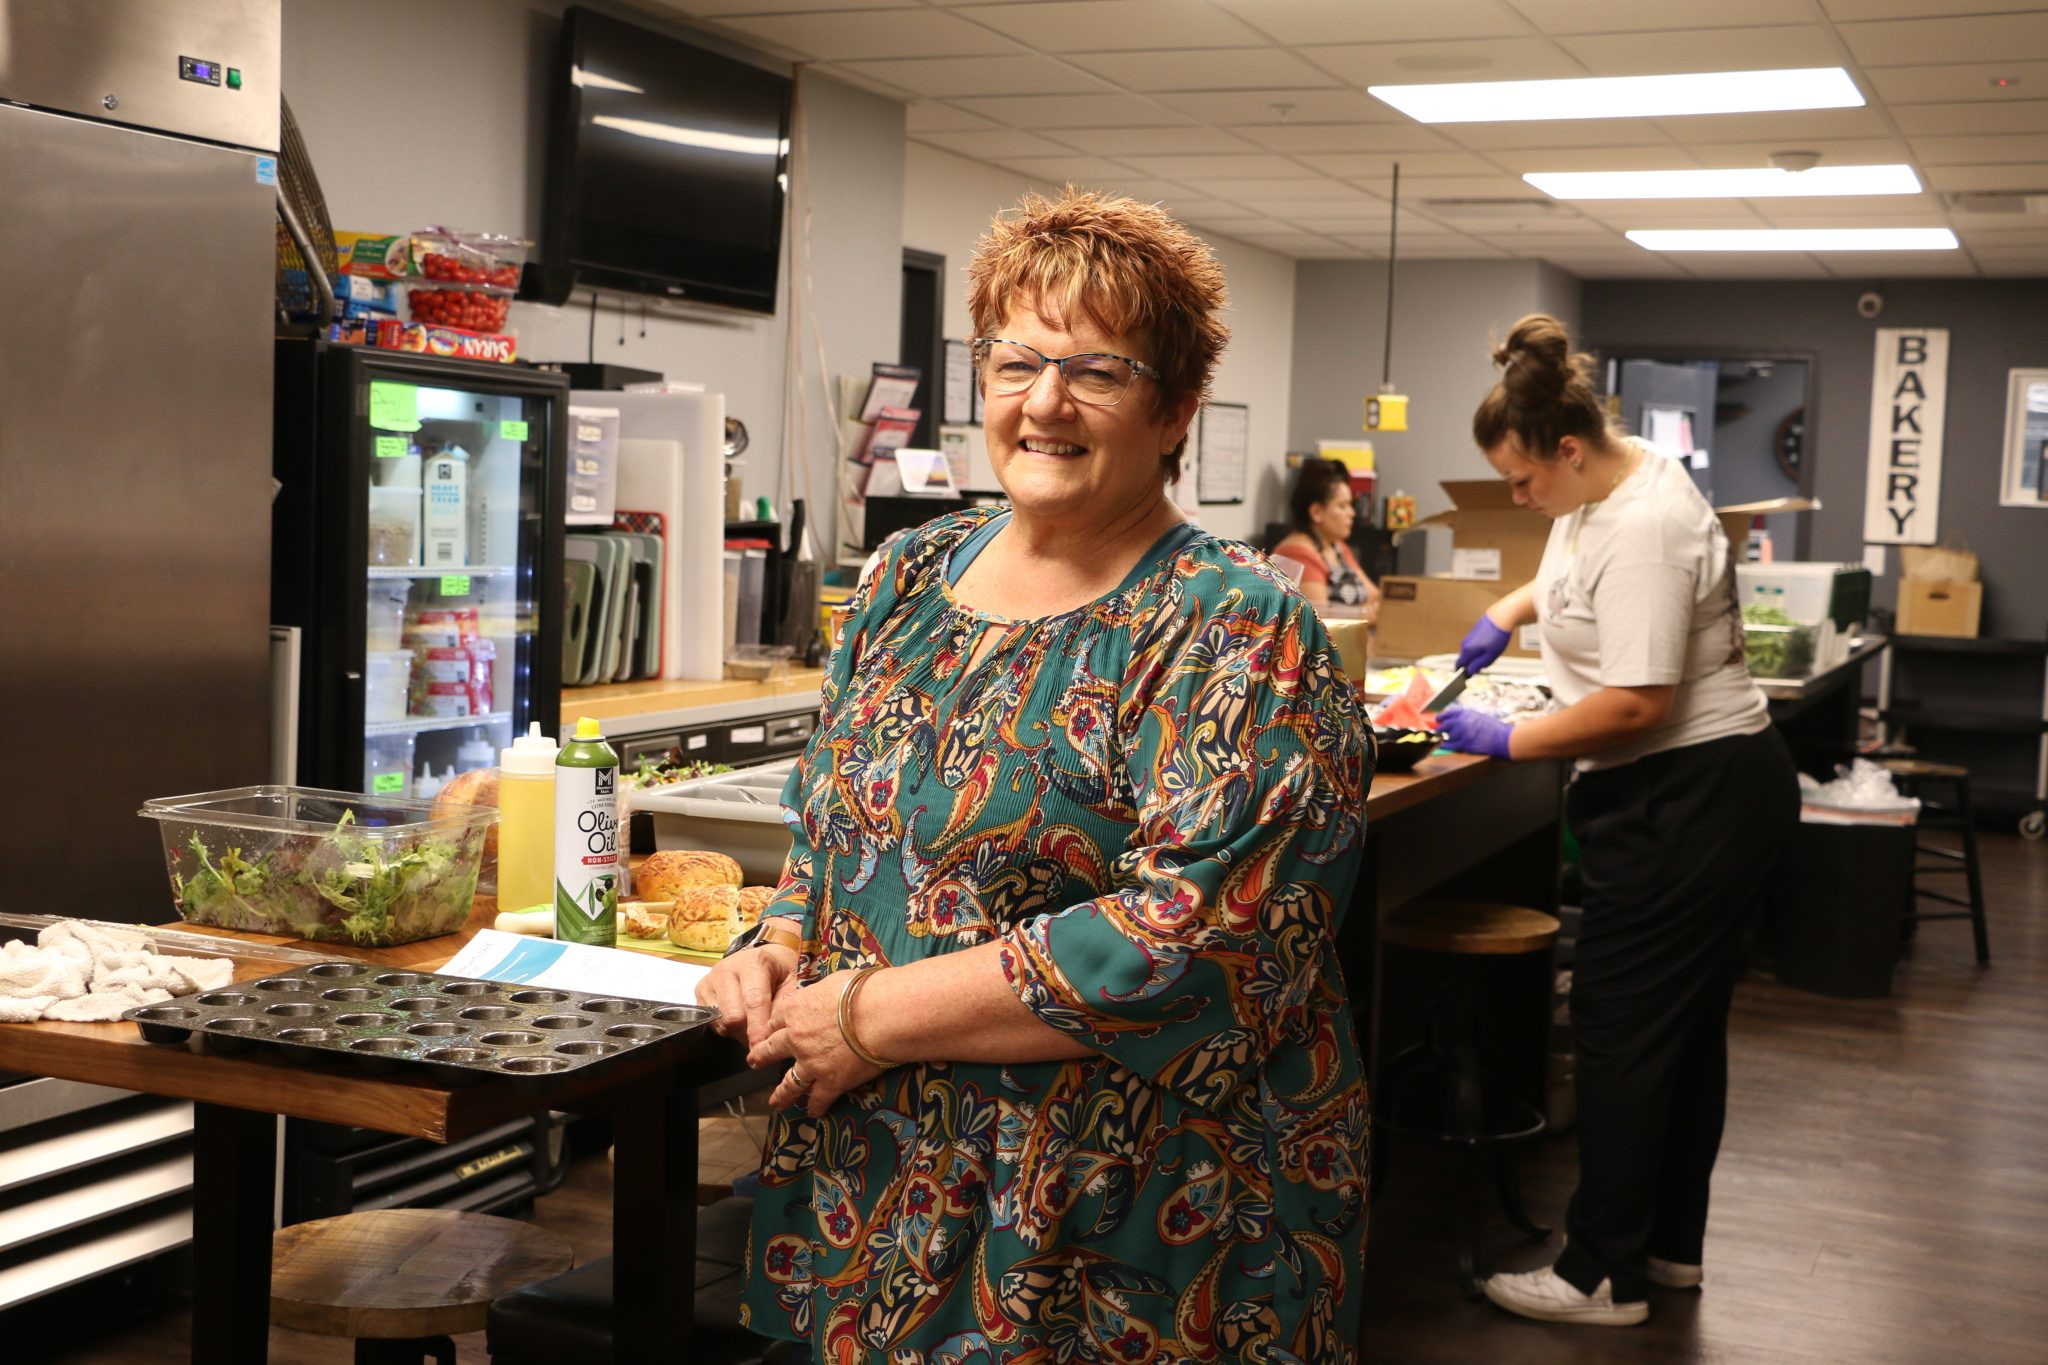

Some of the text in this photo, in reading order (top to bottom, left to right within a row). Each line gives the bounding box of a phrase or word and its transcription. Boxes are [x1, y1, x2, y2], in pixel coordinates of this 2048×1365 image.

[463, 338, 510, 363] SARAN
[1888, 336, 1928, 535] BAKERY
[587, 831, 616, 854] Oil
